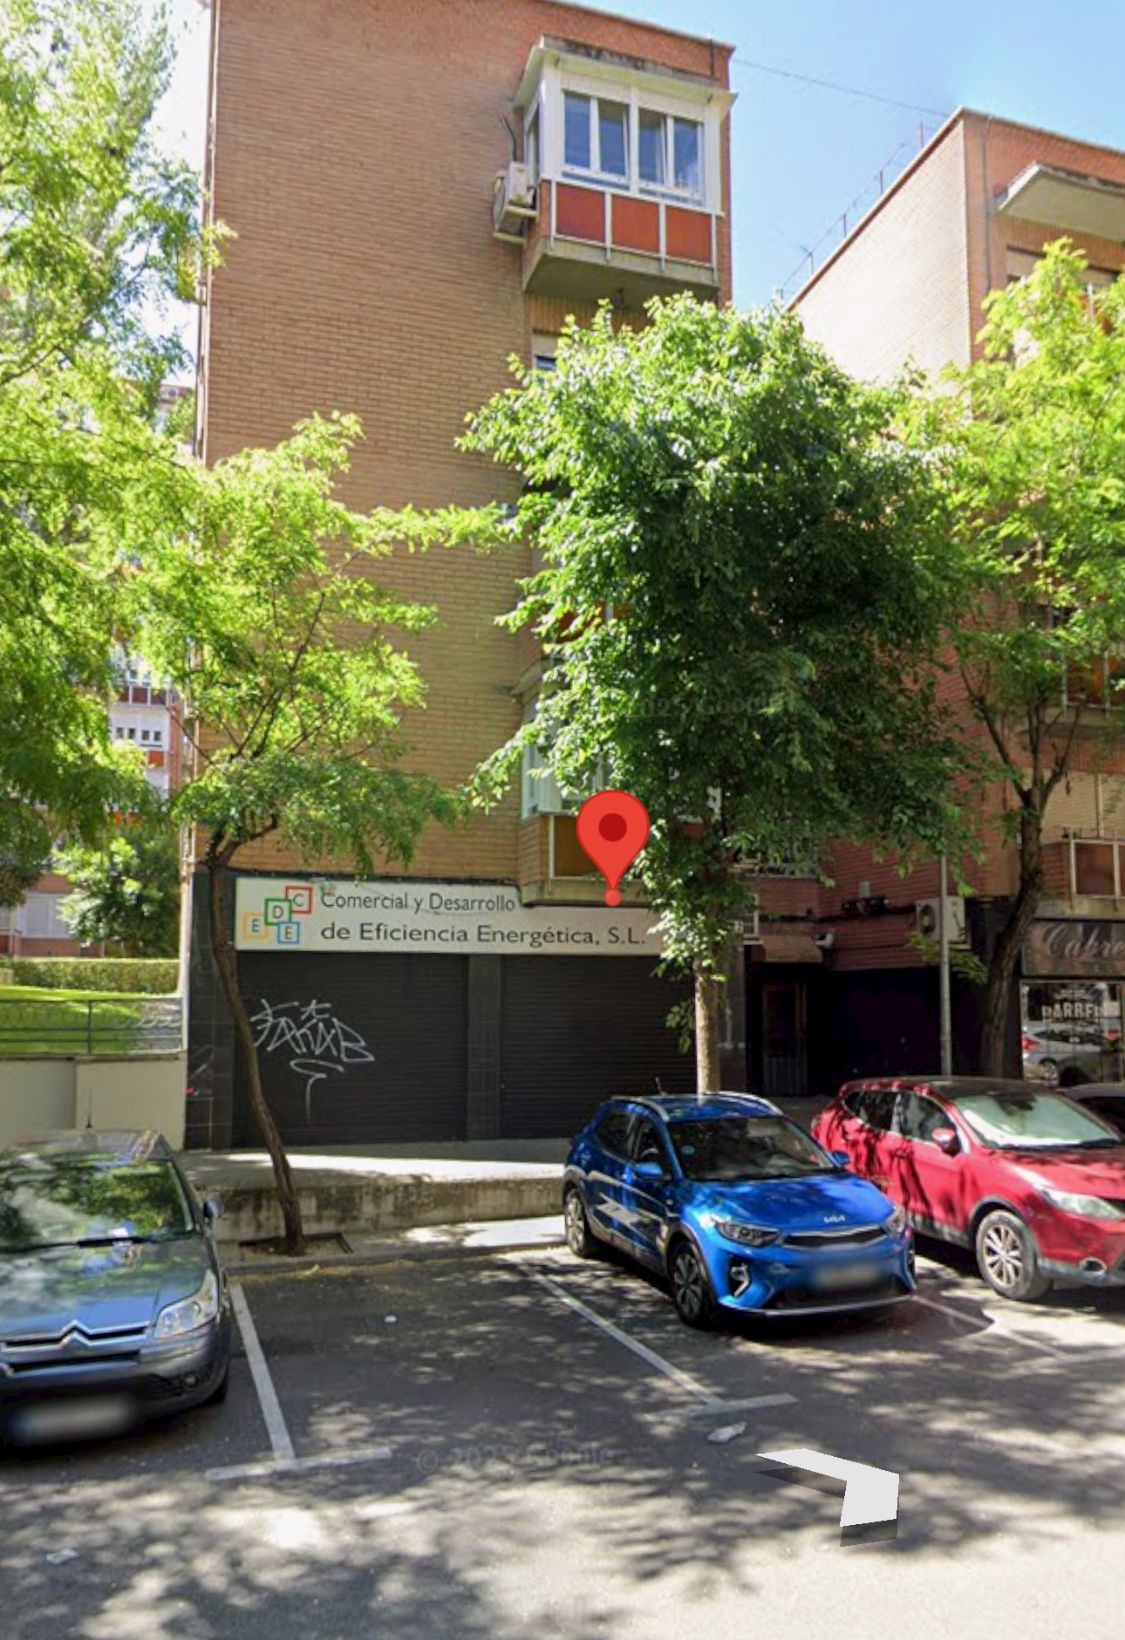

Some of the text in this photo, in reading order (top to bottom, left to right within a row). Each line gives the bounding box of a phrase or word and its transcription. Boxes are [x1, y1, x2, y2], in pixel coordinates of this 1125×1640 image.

[293, 893, 305, 907] C
[321, 892, 516, 914] Comercial y Desarrollo
[272, 905, 284, 919] D
[321, 922, 645, 948] de Eficiencia Energética, S.L.
